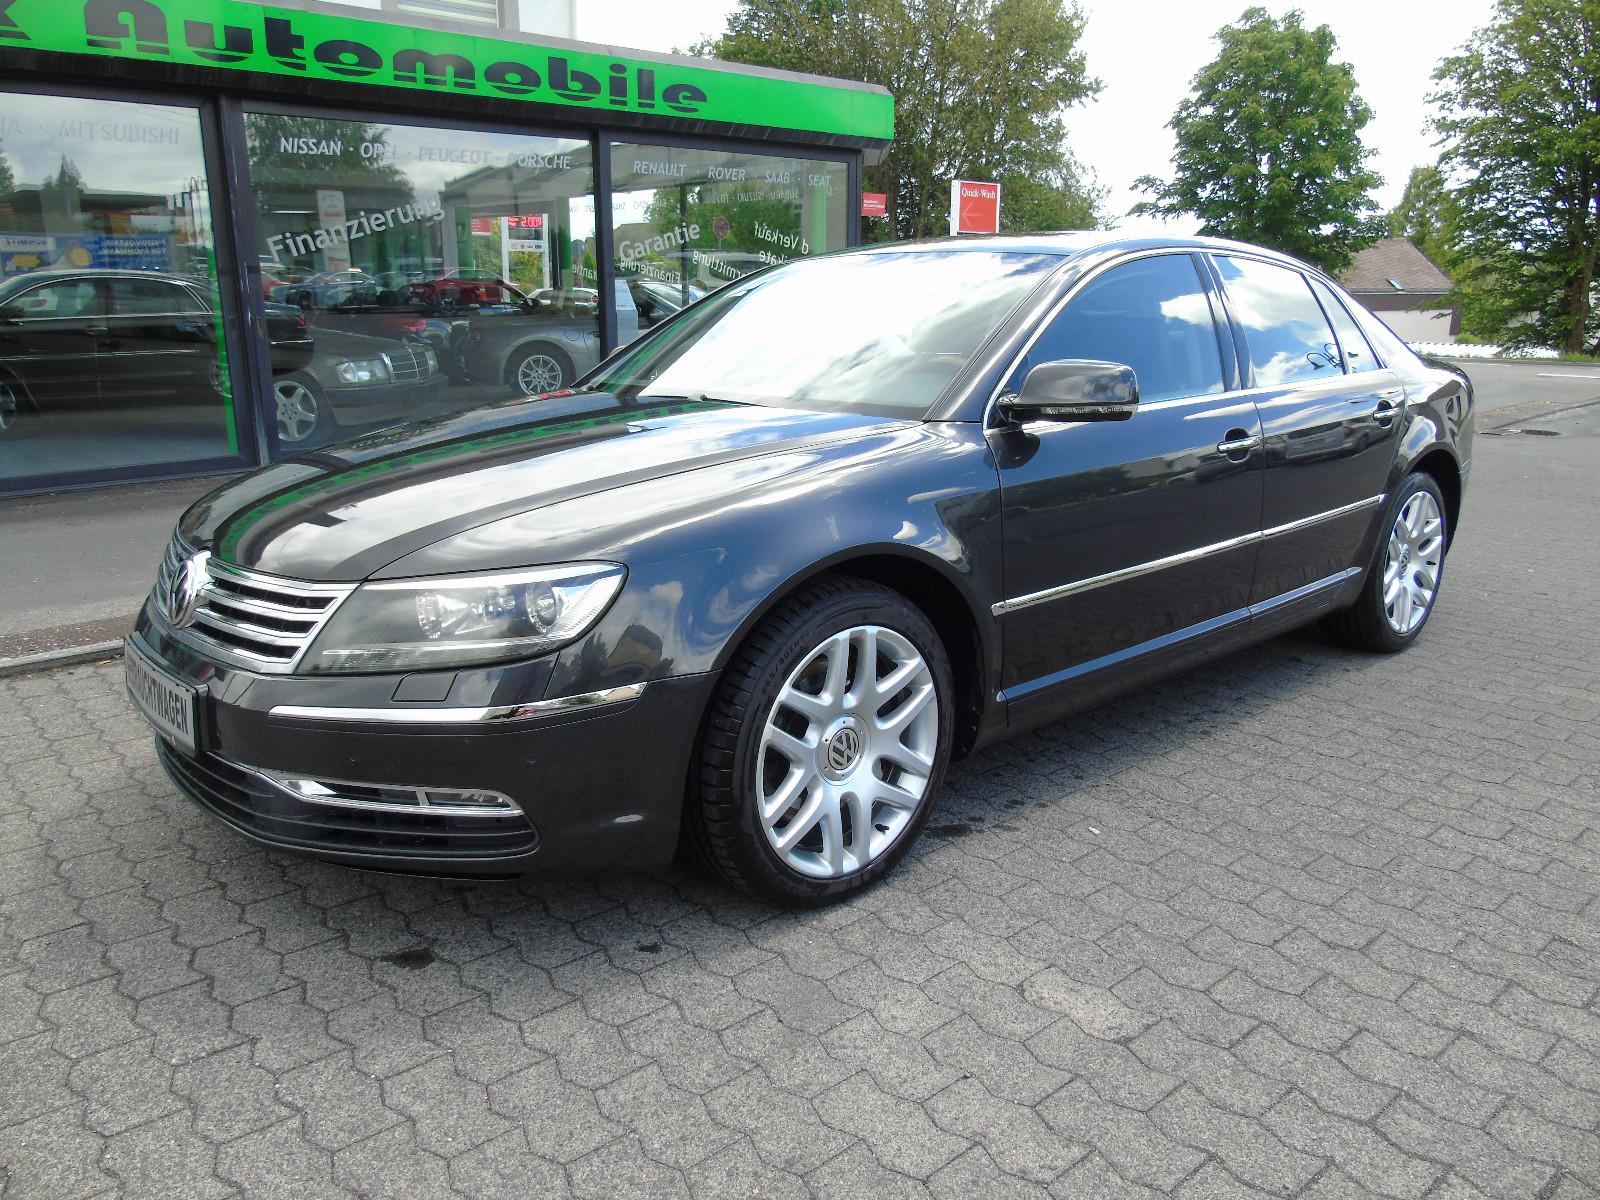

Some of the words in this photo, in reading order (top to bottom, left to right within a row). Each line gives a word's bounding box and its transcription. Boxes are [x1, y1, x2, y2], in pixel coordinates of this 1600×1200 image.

[84, 0, 708, 113] Automobile
[58, 119, 181, 145] MITSUBISHI
[280, 136, 342, 156] NISSAN
[360, 142, 397, 160] OPEL
[418, 146, 491, 164] PEUGEOT
[507, 152, 572, 170] PORSCHE
[633, 160, 687, 177] RENAULT
[708, 166, 746, 181] ROVER
[765, 171, 790, 184] SAAB
[808, 174, 832, 187] SEAT
[961, 187, 996, 199] Quick-Wash
[266, 199, 446, 263] Finanzierung
[620, 222, 700, 261] Garantie
